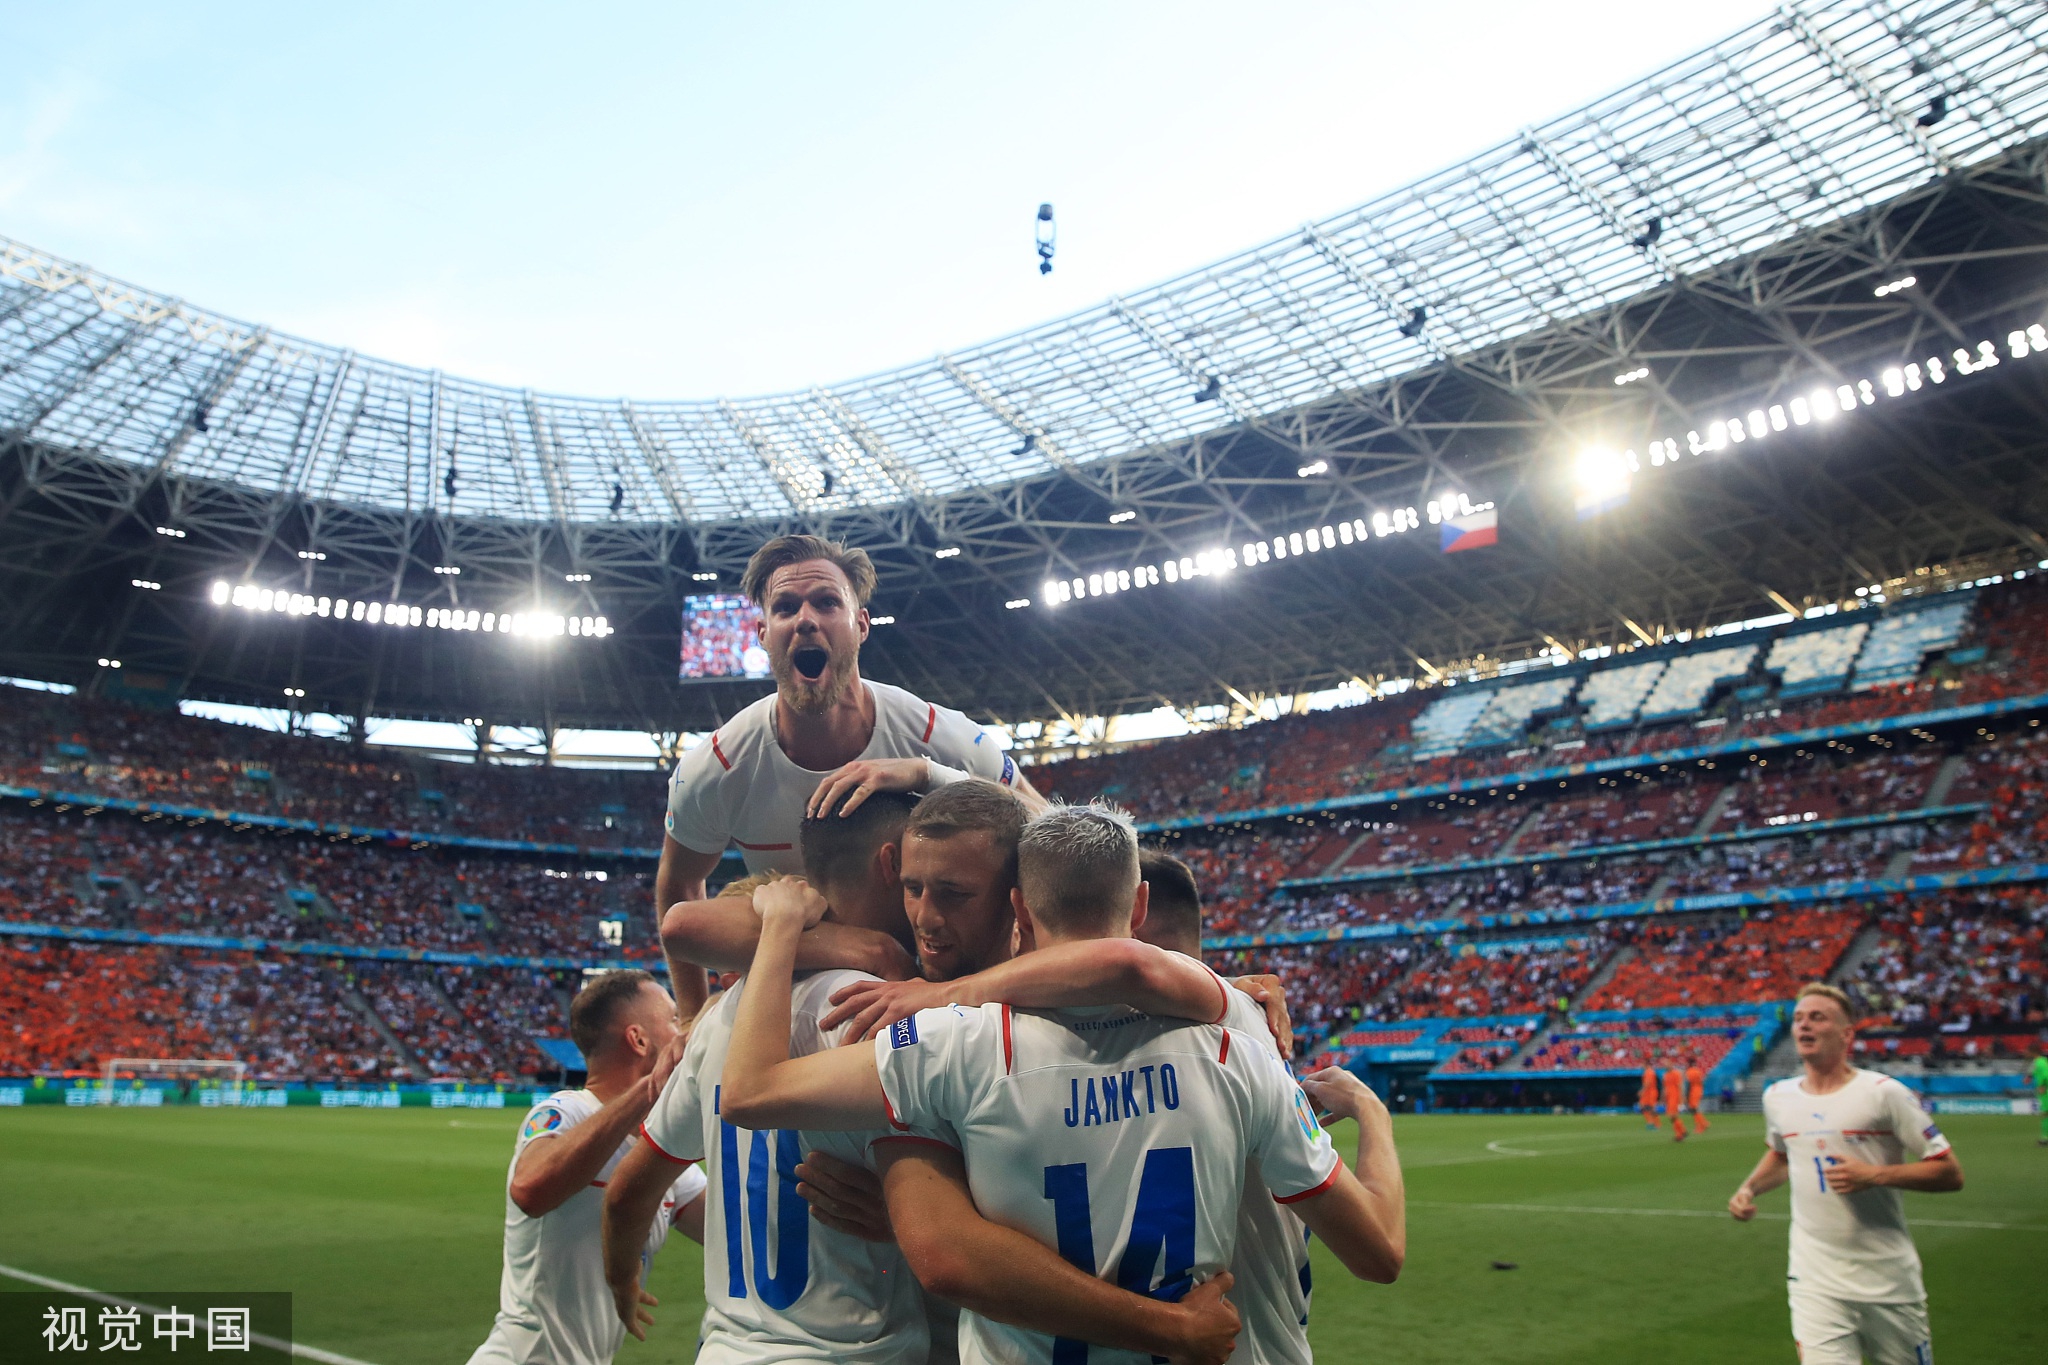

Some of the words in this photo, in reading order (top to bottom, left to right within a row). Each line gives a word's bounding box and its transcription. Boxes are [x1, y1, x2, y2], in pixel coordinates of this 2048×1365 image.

[714, 1084, 809, 1311] 10
[1064, 1063, 1179, 1127] JANKTO
[1044, 1147, 1196, 1365] 14
